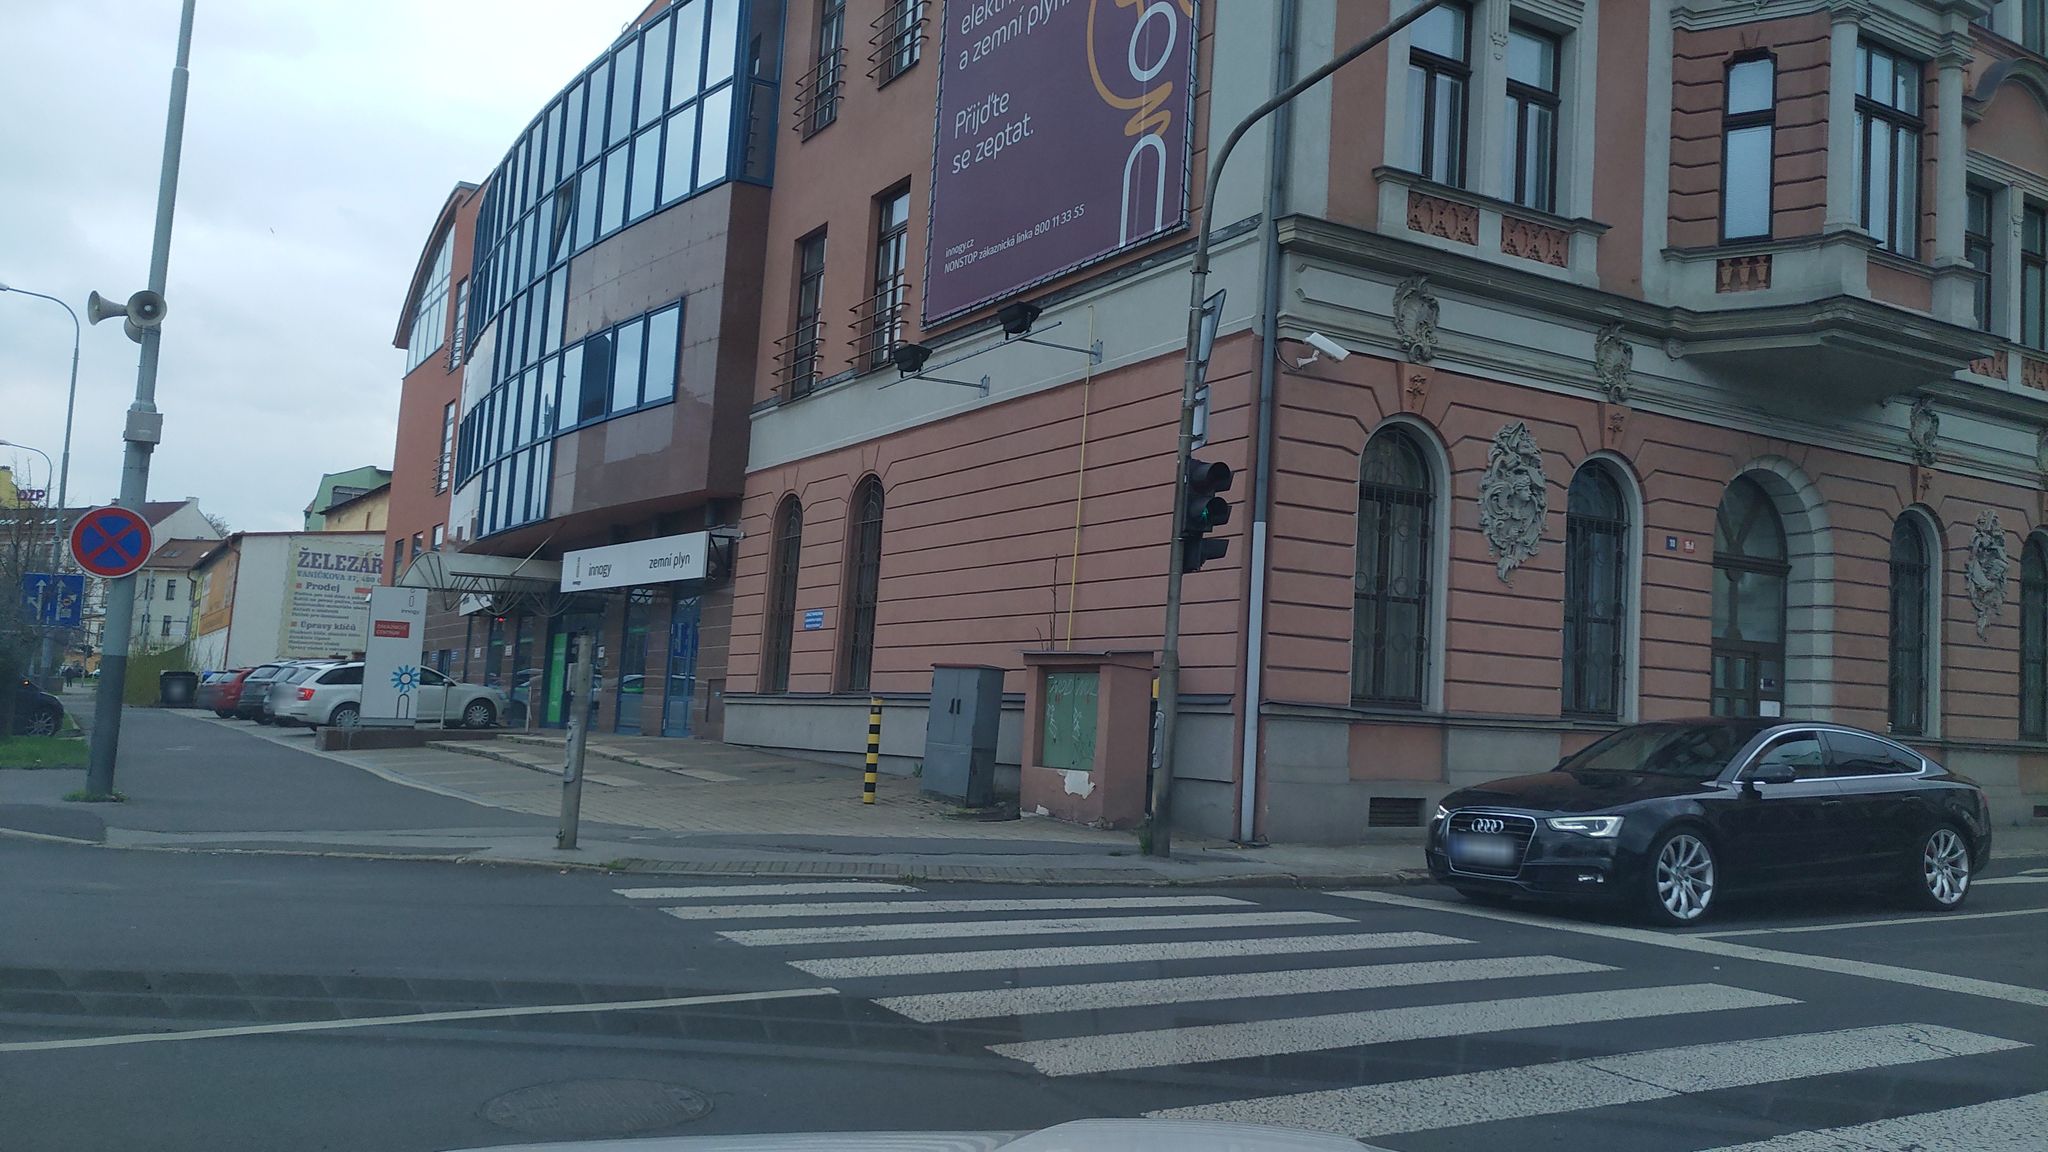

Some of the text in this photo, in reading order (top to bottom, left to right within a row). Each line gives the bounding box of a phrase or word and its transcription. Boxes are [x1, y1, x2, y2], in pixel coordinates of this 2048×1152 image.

[959, 50, 969, 70] a
[972, 5, 1024, 62] zemní
[955, 92, 1010, 139] Přijďte
[952, 112, 1034, 174] se zeptat.
[944, 203, 1085, 274] NONSTOP zákaznická linka 800 11 33 55
[945, 238, 975, 258] innogy.cz
[297, 547, 384, 574] ŽELEZÁŘ
[588, 563, 612, 578] innogy
[649, 551, 691, 569] zemní plyn
[305, 581, 340, 593] Prodej
